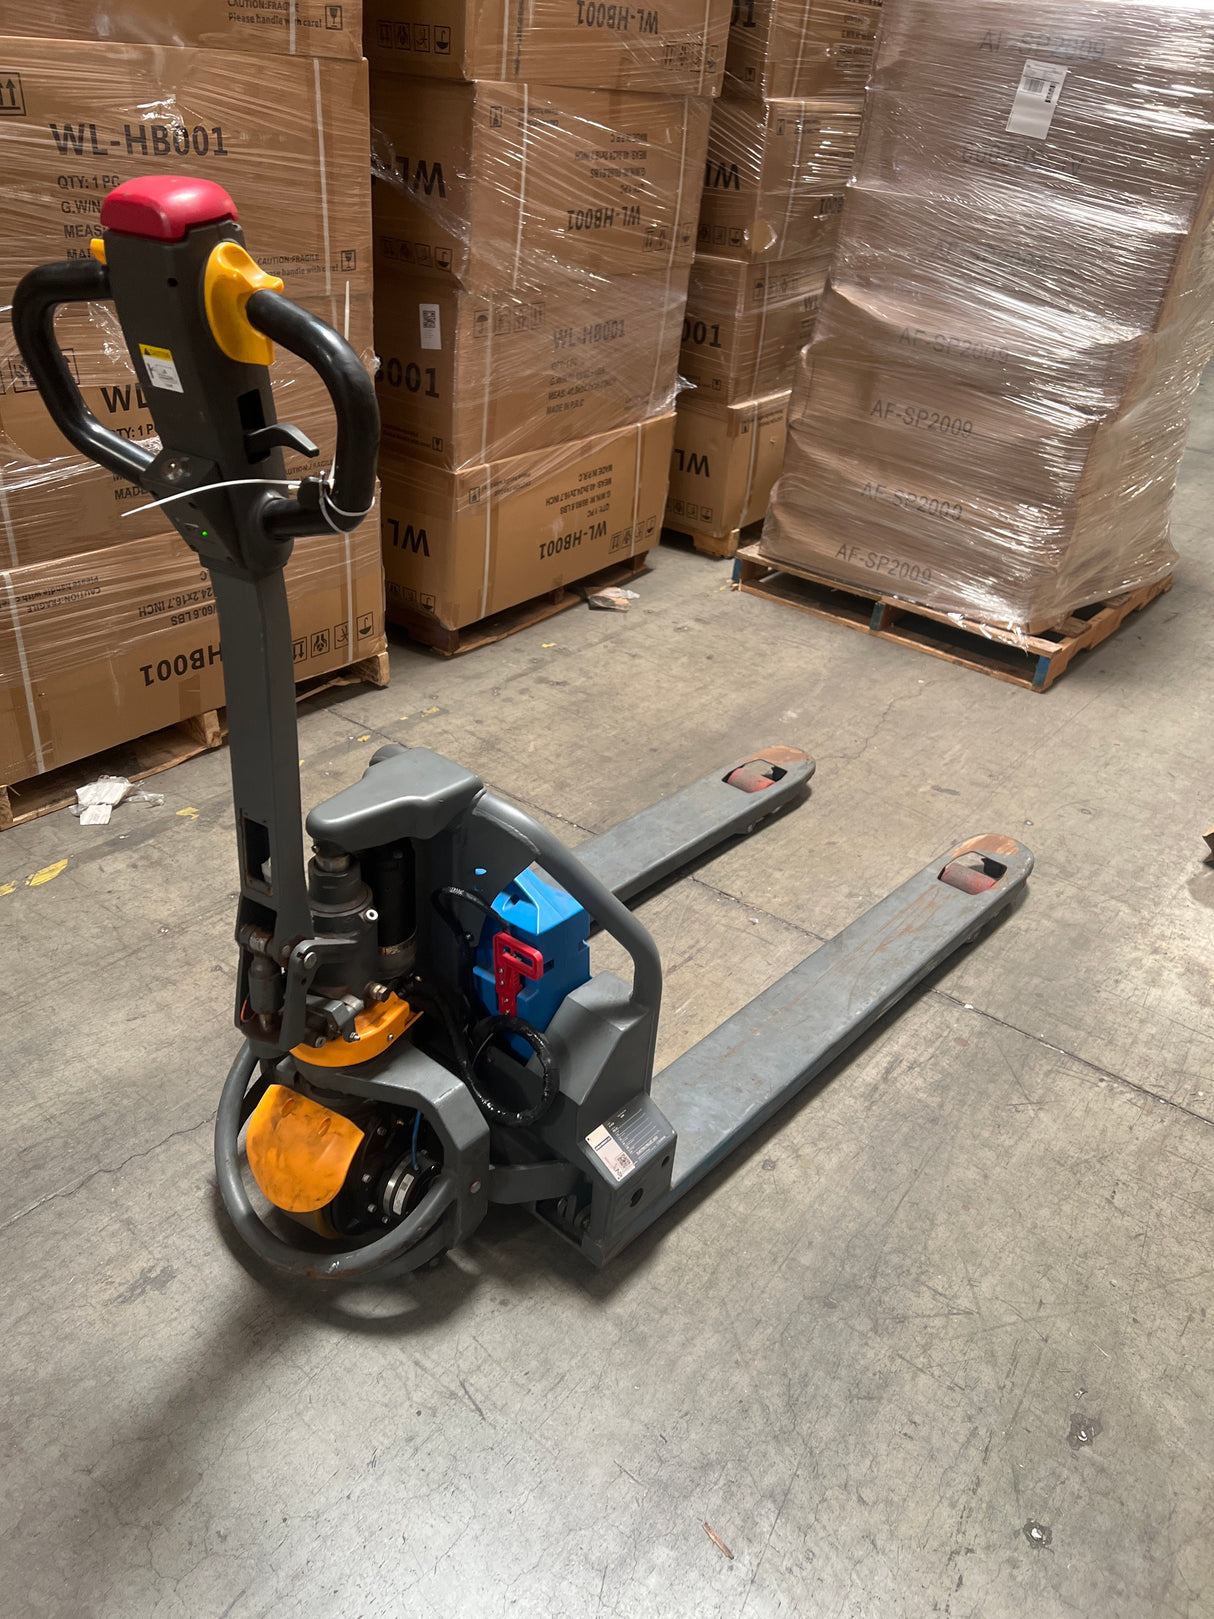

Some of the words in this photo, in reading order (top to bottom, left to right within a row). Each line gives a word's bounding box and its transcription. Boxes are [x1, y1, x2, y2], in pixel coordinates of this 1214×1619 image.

[228, 0, 299, 12] CAUTION:FRAGE
[256, 14, 283, 25] handle
[284, 18, 302, 26] wh
[577, 0, 659, 35] WL-HB001
[49, 123, 229, 156] WL-HB001
[58, 176, 88, 190] QTY:
[92, 176, 98, 188] 1
[566, 206, 641, 231] WL-HB001
[870, 398, 973, 438] AF-SP2009
[111, 427, 135, 438] TY:
[540, 520, 607, 560] WL-HB001
[835, 543, 932, 585] AF-SP2009
[168, 588, 213, 608] 24.2x16.7
[138, 601, 166, 617] INCH
[170, 612, 192, 626] LBS
